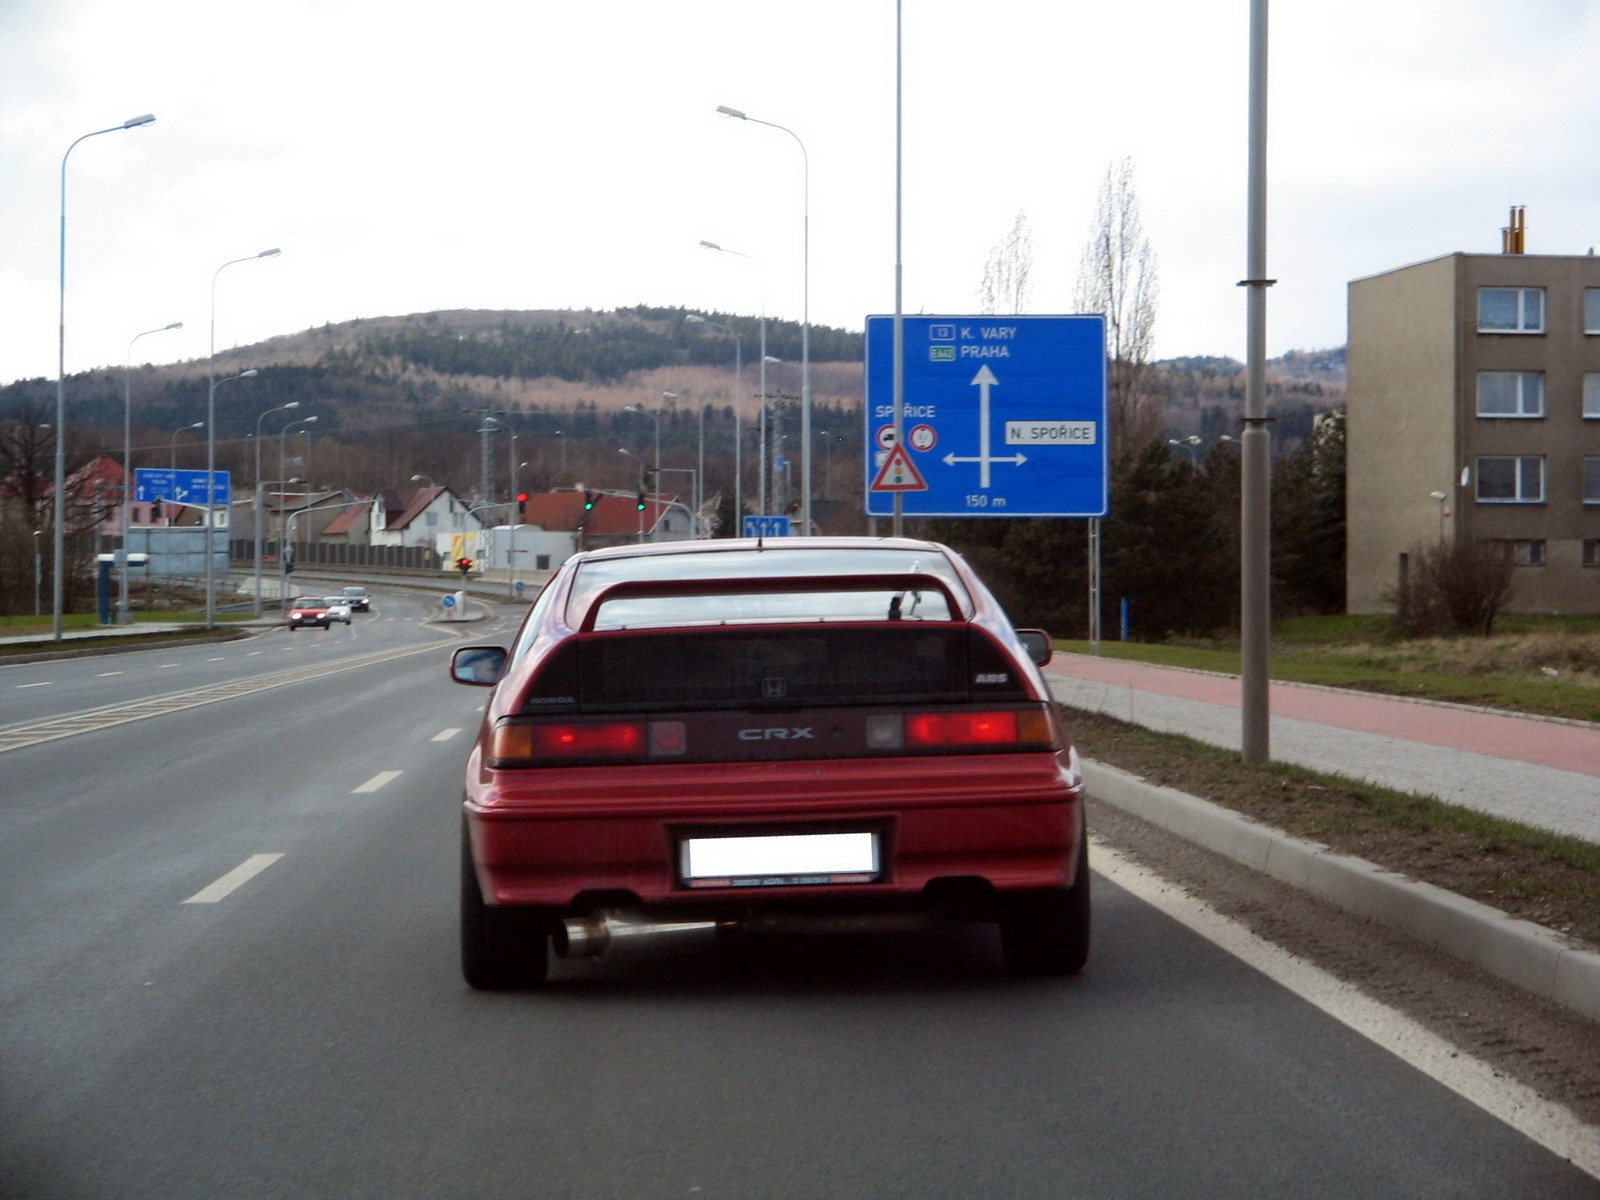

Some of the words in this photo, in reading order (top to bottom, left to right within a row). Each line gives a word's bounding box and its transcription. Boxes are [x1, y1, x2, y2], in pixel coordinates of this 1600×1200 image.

[960, 327, 974, 339] K.
[980, 327, 1017, 339] VARY
[960, 345, 1009, 358] PRAHA
[875, 403, 936, 418] SPŘICE
[1010, 427, 1023, 439] N.
[1031, 424, 1090, 439] SPOŘICE
[965, 495, 987, 508] 150
[993, 497, 1006, 508] m
[738, 727, 816, 741] CRX
